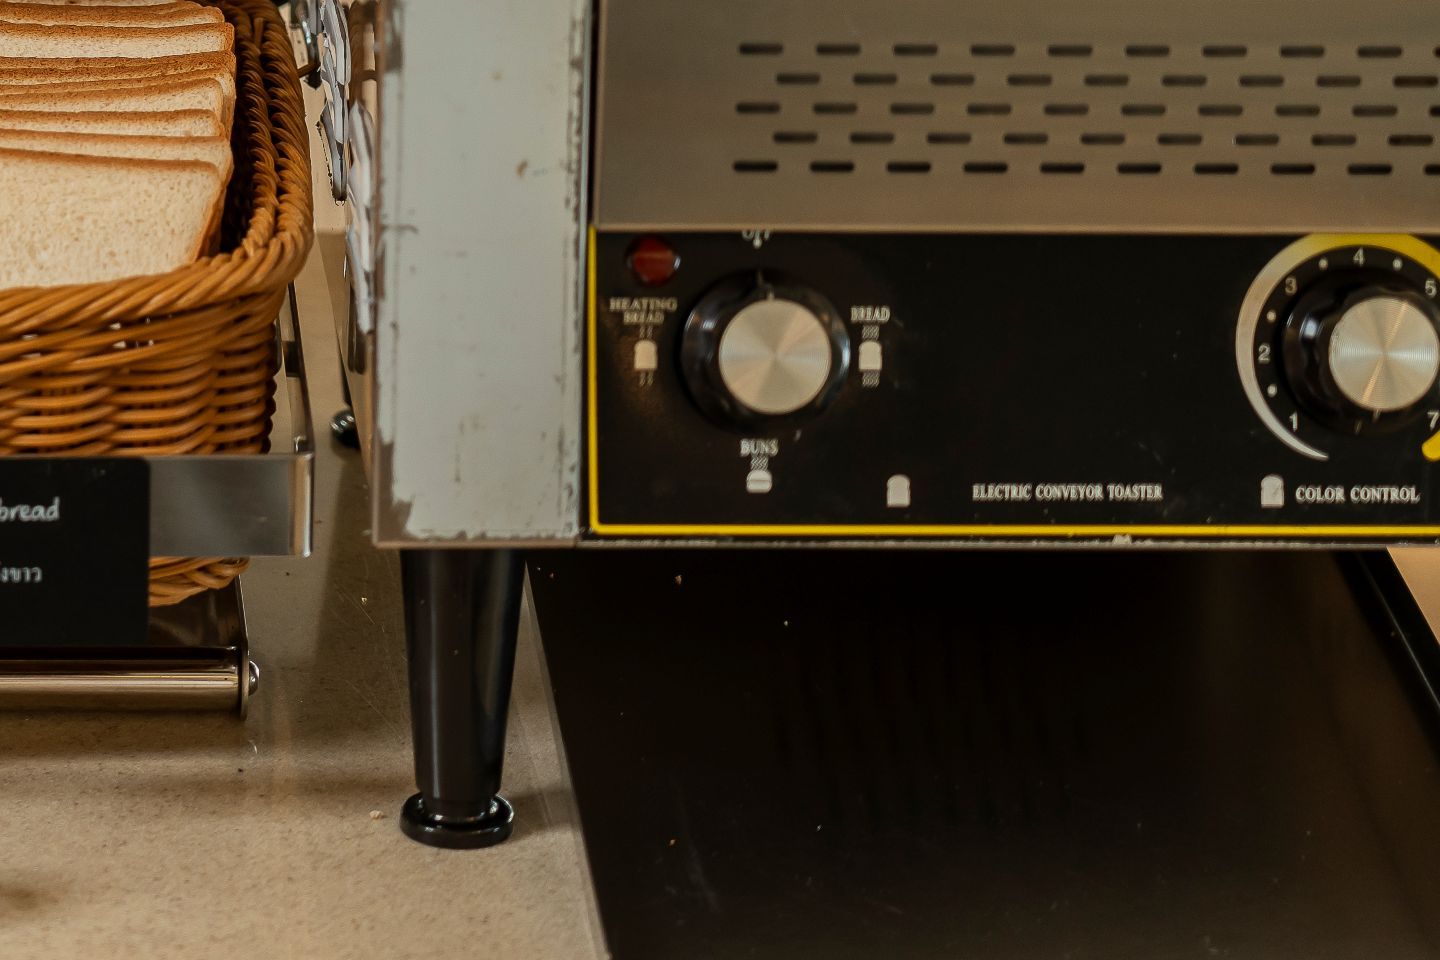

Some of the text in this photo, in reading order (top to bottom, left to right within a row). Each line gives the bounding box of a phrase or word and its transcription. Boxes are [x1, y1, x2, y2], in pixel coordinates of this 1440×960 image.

[1353, 248, 1365, 266] 4
[1285, 276, 1297, 295] 3
[1424, 278, 1437, 298] 5
[609, 297, 678, 313] HEATING
[850, 305, 891, 322] BREAD
[1258, 344, 1271, 363] 2
[1289, 412, 1298, 431] 1
[1427, 411, 1440, 430] 7
[740, 438, 779, 456] BUNS
[972, 483, 1163, 501] ELECTRIC CONVEYOR TOASTER
[1295, 486, 1421, 504] COLOR CONTROL
